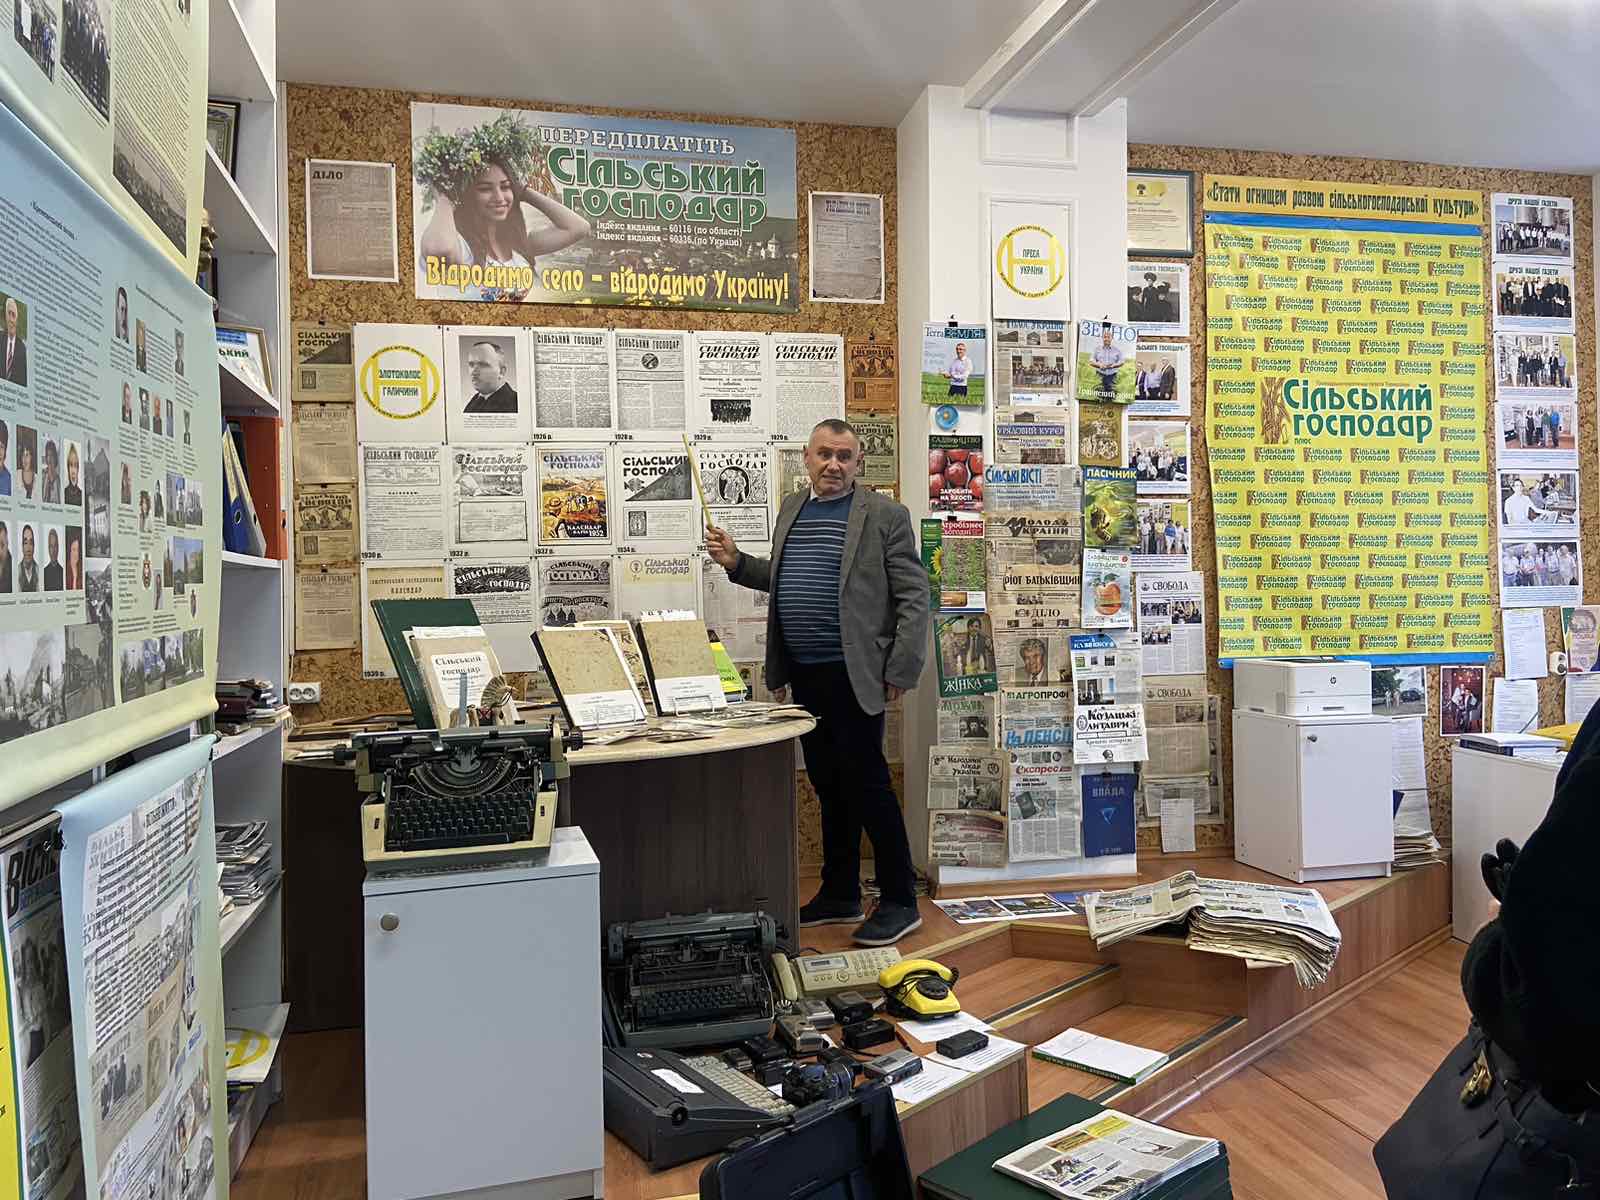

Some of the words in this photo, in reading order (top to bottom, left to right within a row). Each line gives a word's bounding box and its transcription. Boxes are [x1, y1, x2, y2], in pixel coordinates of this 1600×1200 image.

[538, 125, 736, 155] ПЕРЕДПЛАТІТЬ
[312, 171, 343, 181] ДІЛО
[547, 147, 766, 195] Сільський
[1207, 181, 1240, 203] «Стати
[1246, 188, 1287, 206] огнищем
[1293, 191, 1324, 210] розвою
[1330, 190, 1429, 214] сільськогосподарської
[1433, 200, 1479, 218] культури»
[562, 187, 767, 231] господар
[596, 220, 626, 232] Індекс
[626, 222, 661, 232] видання
[669, 224, 692, 235] 60116
[694, 225, 707, 237] (по
[708, 226, 743, 237] області)
[596, 231, 625, 242] Індекс
[626, 233, 661, 244] видання
[1022, 248, 1040, 258] ПРЕСА
[1020, 265, 1043, 275] УКРАЇНИ
[426, 255, 534, 292] Відродимо
[543, 268, 584, 292] село
[610, 267, 706, 300] відродимо
[714, 270, 788, 305] Україну!
[926, 327, 944, 337] Terra
[1081, 320, 1136, 341] ЗЕНО
[383, 387, 418, 396] ГАЛИЧИНИ
[1283, 379, 1432, 412] Сільський
[1293, 413, 1433, 443] господар
[1021, 468, 1042, 484] ВІСТІ
[1086, 468, 1137, 479] ПАСІЧНИК
[1152, 581, 1188, 591] СВОБОДА
[944, 677, 982, 693] ЖІНКА
[1157, 688, 1192, 698] СВОБОДА
